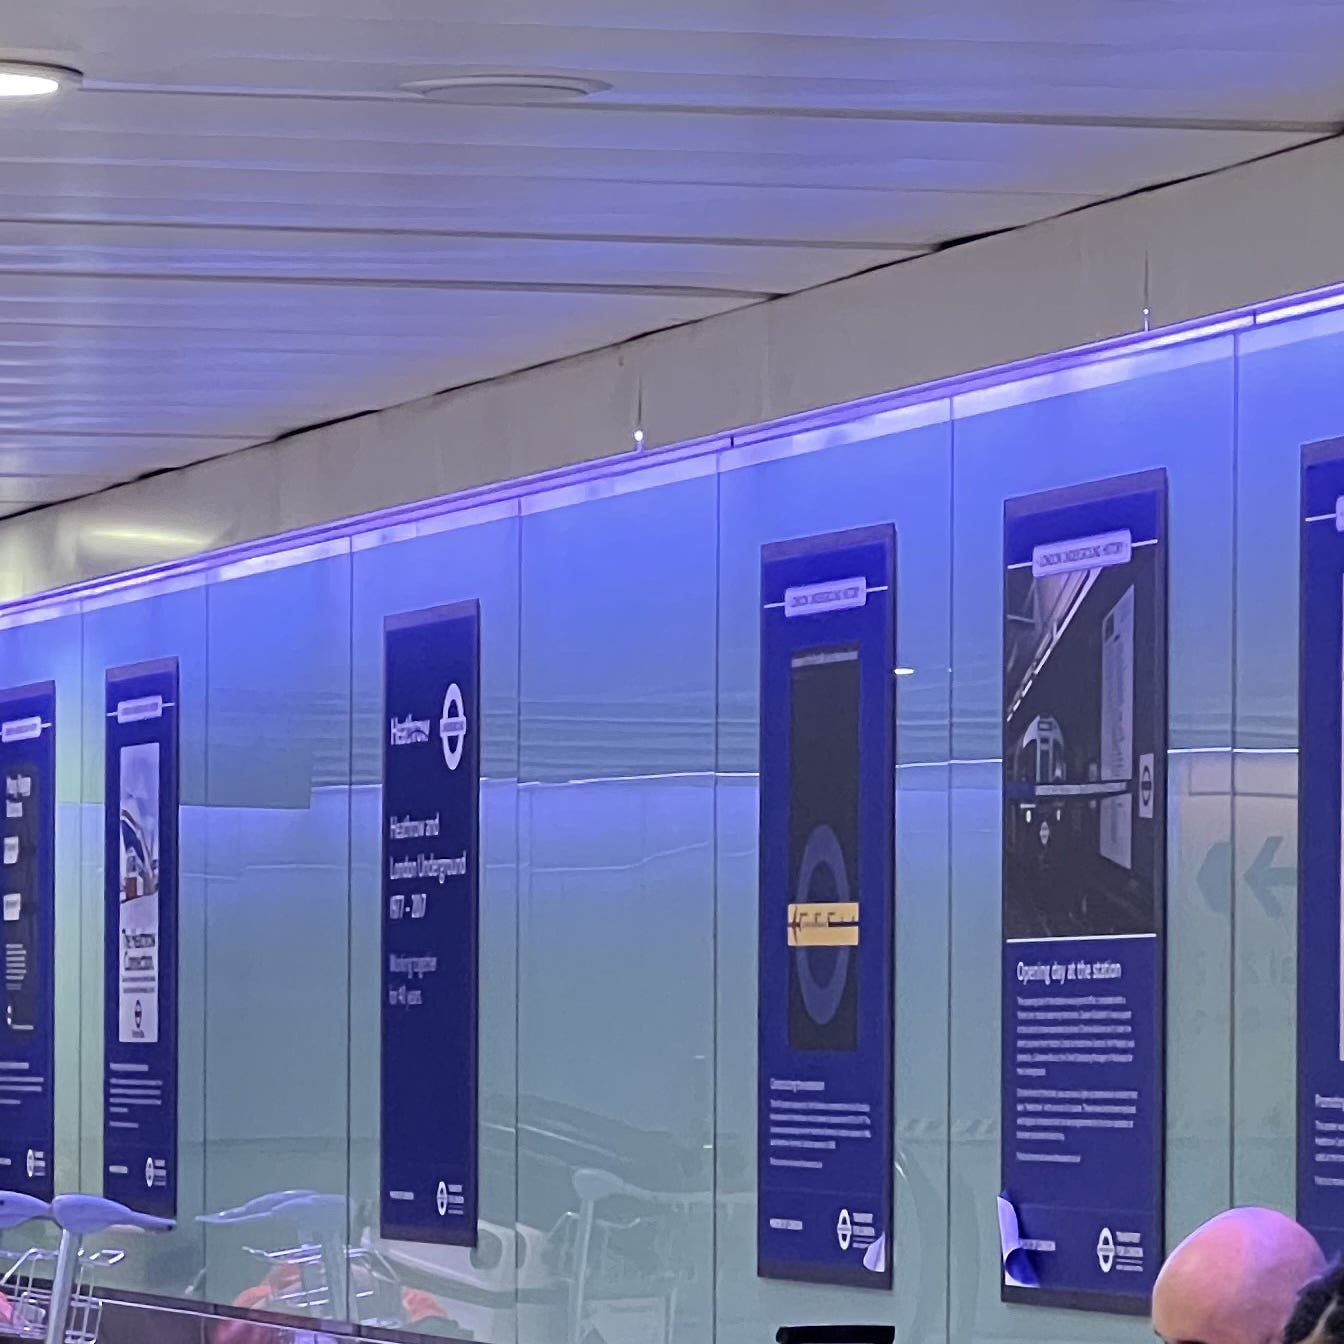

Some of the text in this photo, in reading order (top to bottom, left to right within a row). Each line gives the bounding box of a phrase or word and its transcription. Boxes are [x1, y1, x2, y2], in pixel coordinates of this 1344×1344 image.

[1017, 960, 1122, 985] Opening day at the station
